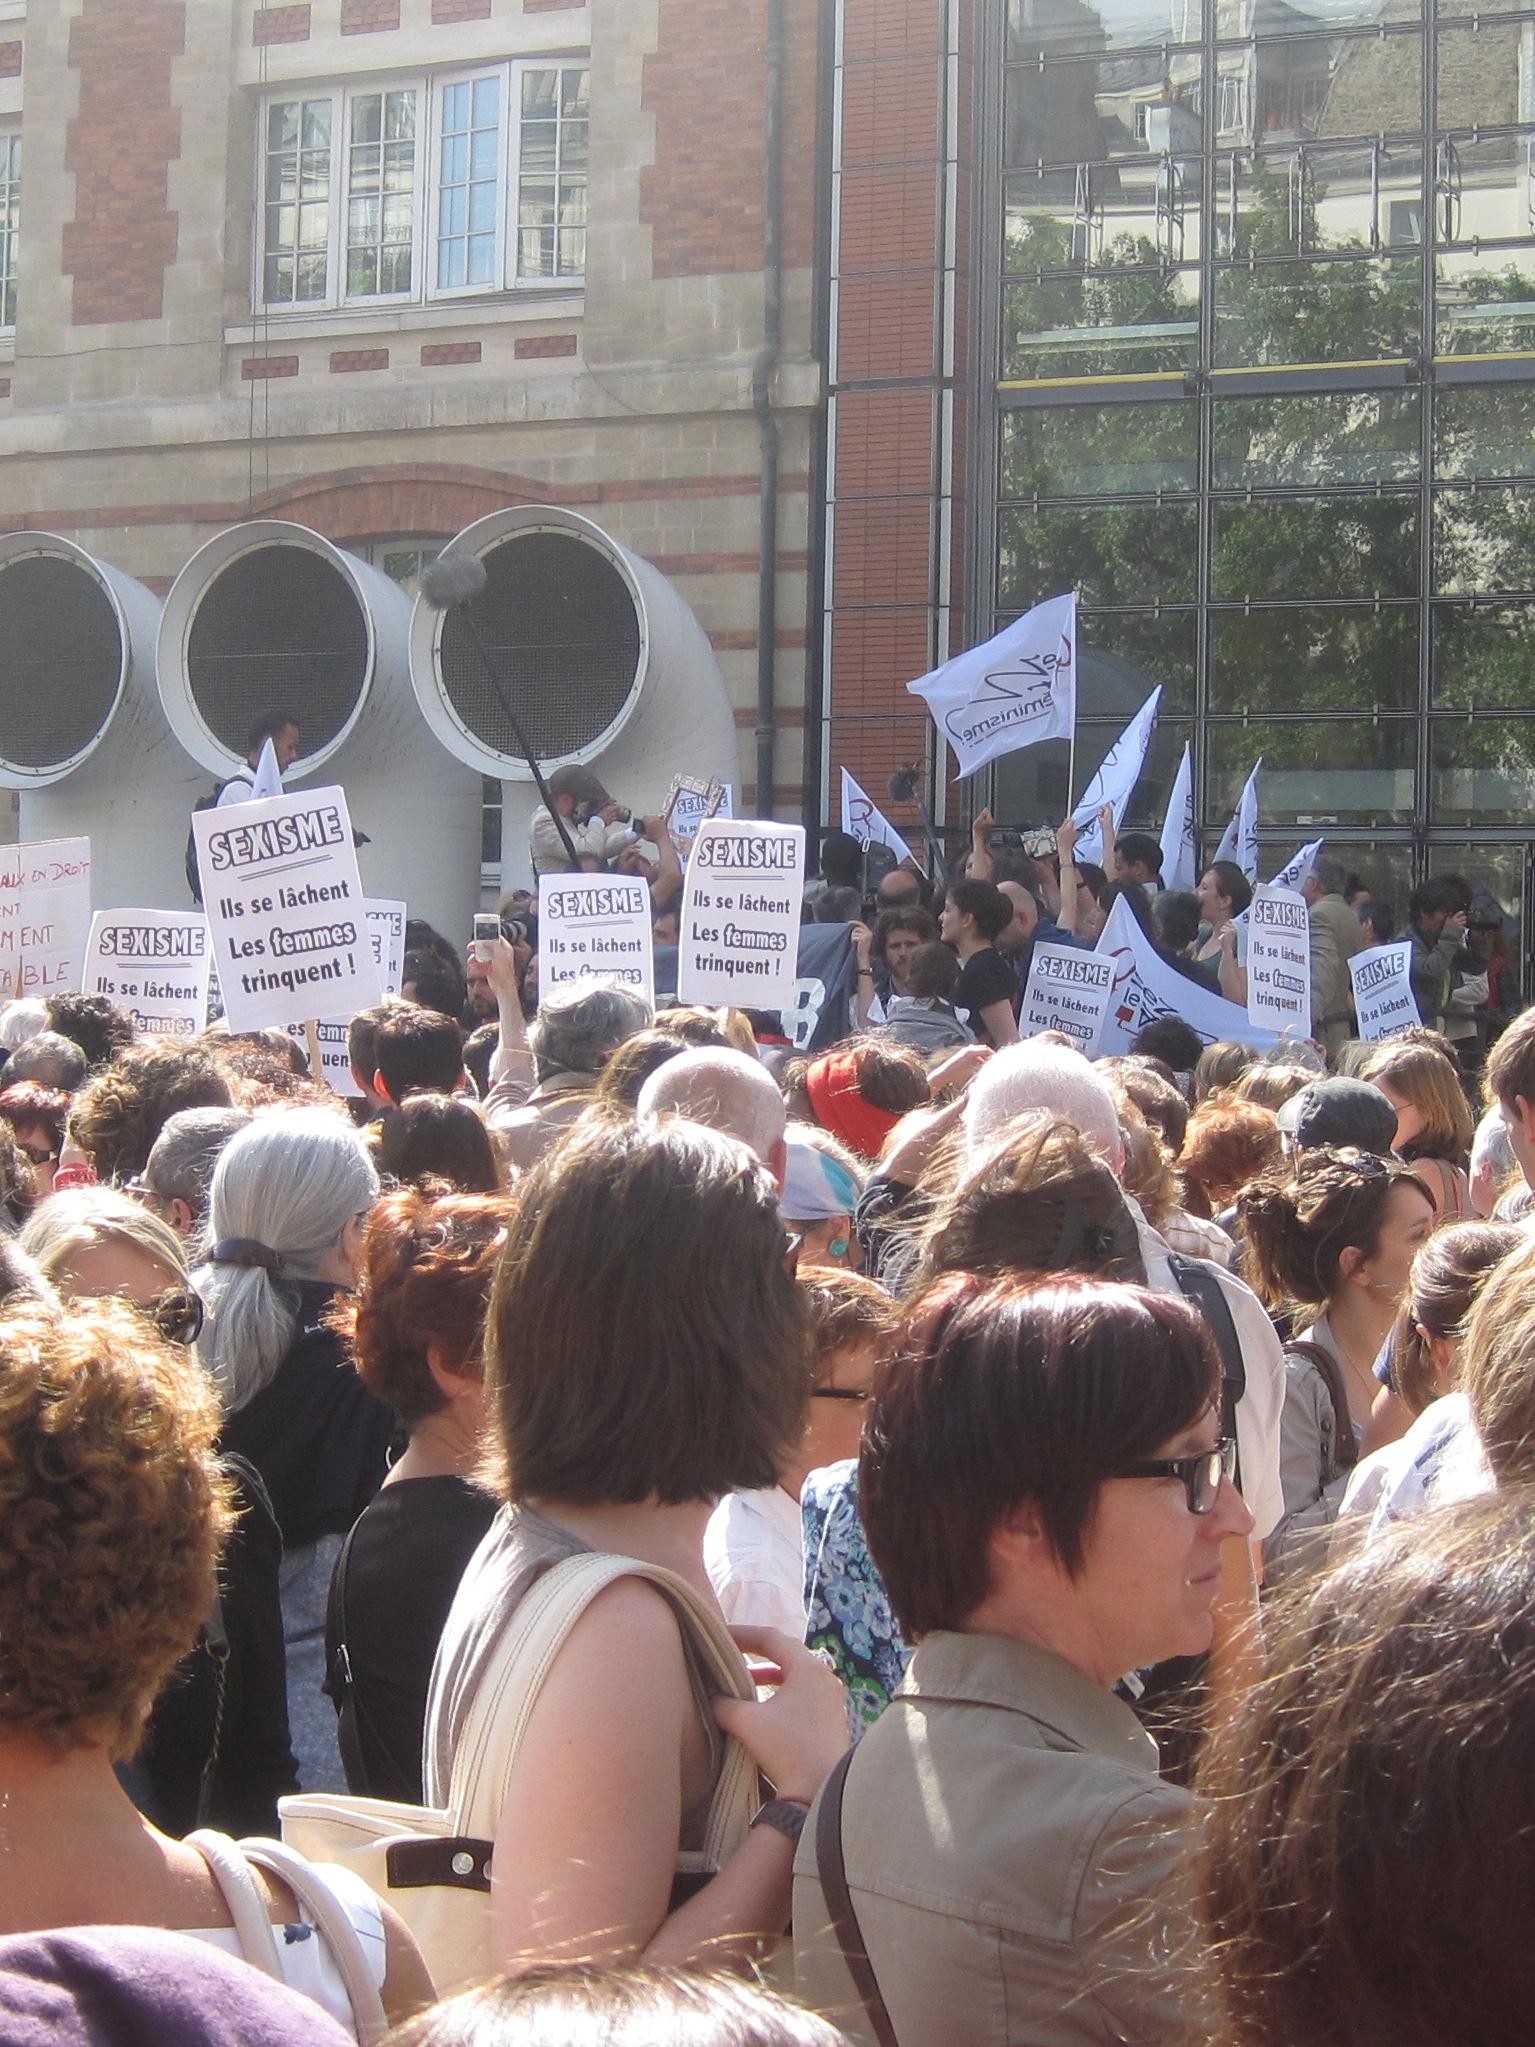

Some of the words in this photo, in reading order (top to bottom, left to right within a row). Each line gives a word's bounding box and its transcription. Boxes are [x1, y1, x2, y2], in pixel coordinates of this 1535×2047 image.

[209, 806, 344, 871] SEXISME
[697, 837, 796, 868] SEXISME
[49, 861, 91, 881] DROIT
[0, 902, 21, 918] NT
[220, 898, 244, 919] Ils
[251, 896, 273, 914] se
[278, 880, 350, 909] lâchent
[547, 887, 644, 919] SEXISME
[693, 890, 710, 907] Ils
[715, 895, 733, 909] se
[739, 893, 790, 914] lâchent
[1255, 899, 1306, 931] SEXISME
[99, 927, 205, 957] SEXISME
[228, 937, 265, 960] Les
[269, 922, 357, 957] femmes
[549, 939, 566, 953] Ils
[571, 942, 586, 952] se
[591, 938, 642, 952] lâchent
[692, 922, 719, 942] Les
[723, 923, 787, 951] femmes
[696, 953, 770, 978] trinquent
[774, 958, 781, 976] !
[1253, 942, 1264, 956] Ils
[1267, 947, 1278, 958] se
[1281, 946, 1306, 965] lâchent
[241, 958, 342, 994] trinquent
[347, 953, 356, 975] !
[551, 966, 575, 982] Les
[1037, 956, 1111, 987] SEXISME
[1254, 966, 1270, 983] Les
[1273, 968, 1305, 994] femmes
[1355, 952, 1405, 995] SEXISME
[97, 977, 116, 994] Ils
[120, 983, 138, 995] se
[143, 981, 198, 999] lâchent
[1256, 991, 1297, 1013] trinquent
[1032, 989, 1044, 1002] Ils
[1047, 993, 1059, 1006] se
[1061, 996, 1100, 1016] lâchent
[1370, 1009, 1379, 1020] se
[1029, 1010, 1048, 1025] Les
[1050, 1014, 1093, 1040] femmes
